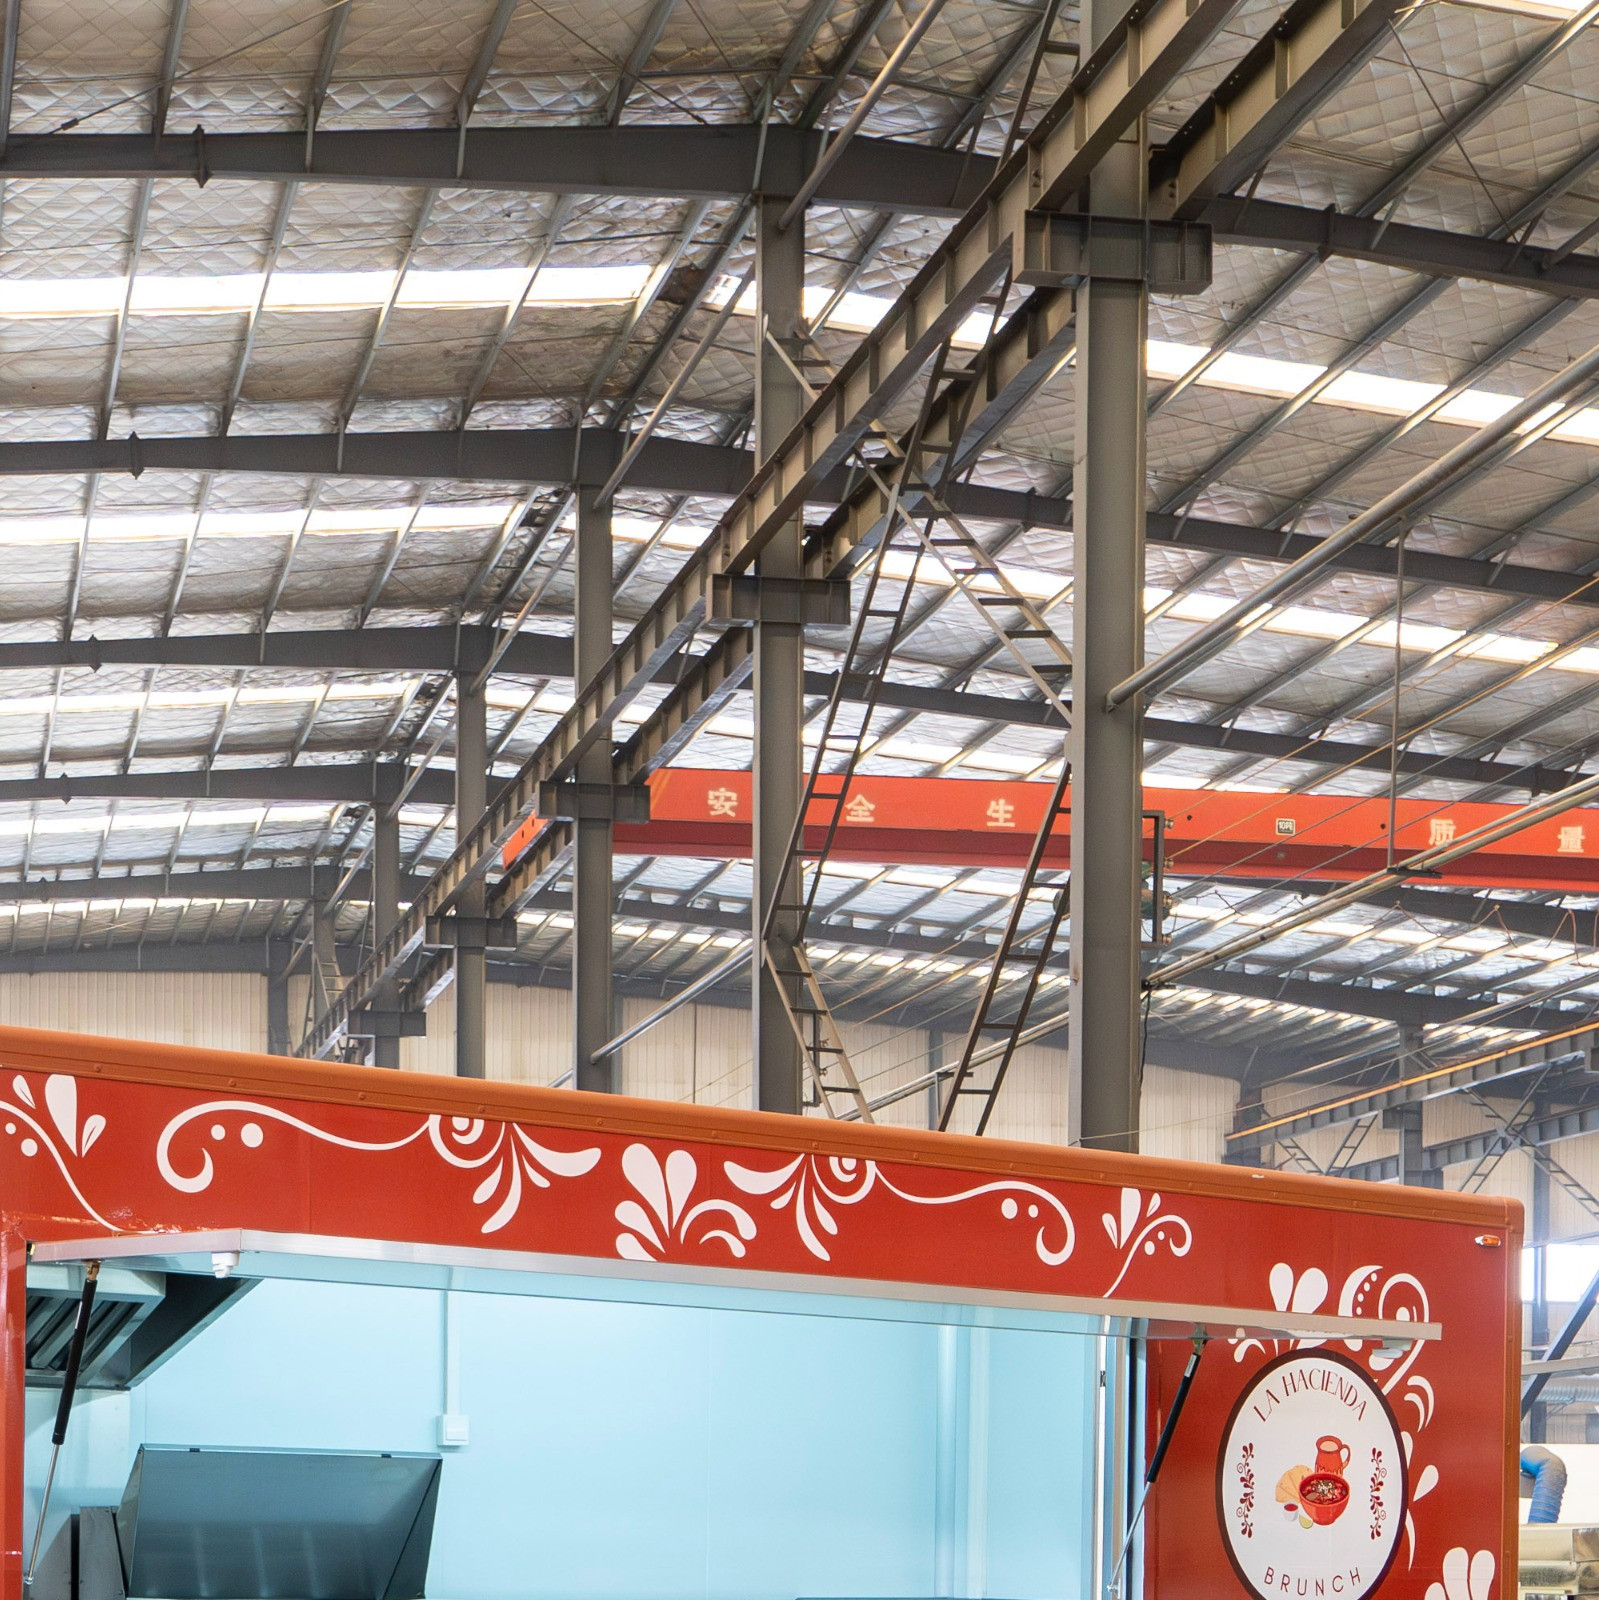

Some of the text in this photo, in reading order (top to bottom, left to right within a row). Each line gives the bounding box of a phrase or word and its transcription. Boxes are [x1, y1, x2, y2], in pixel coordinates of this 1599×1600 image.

[1253, 1367, 1368, 1422] LA HACIENDA
[1264, 1566, 1362, 1598] BRUNCH
